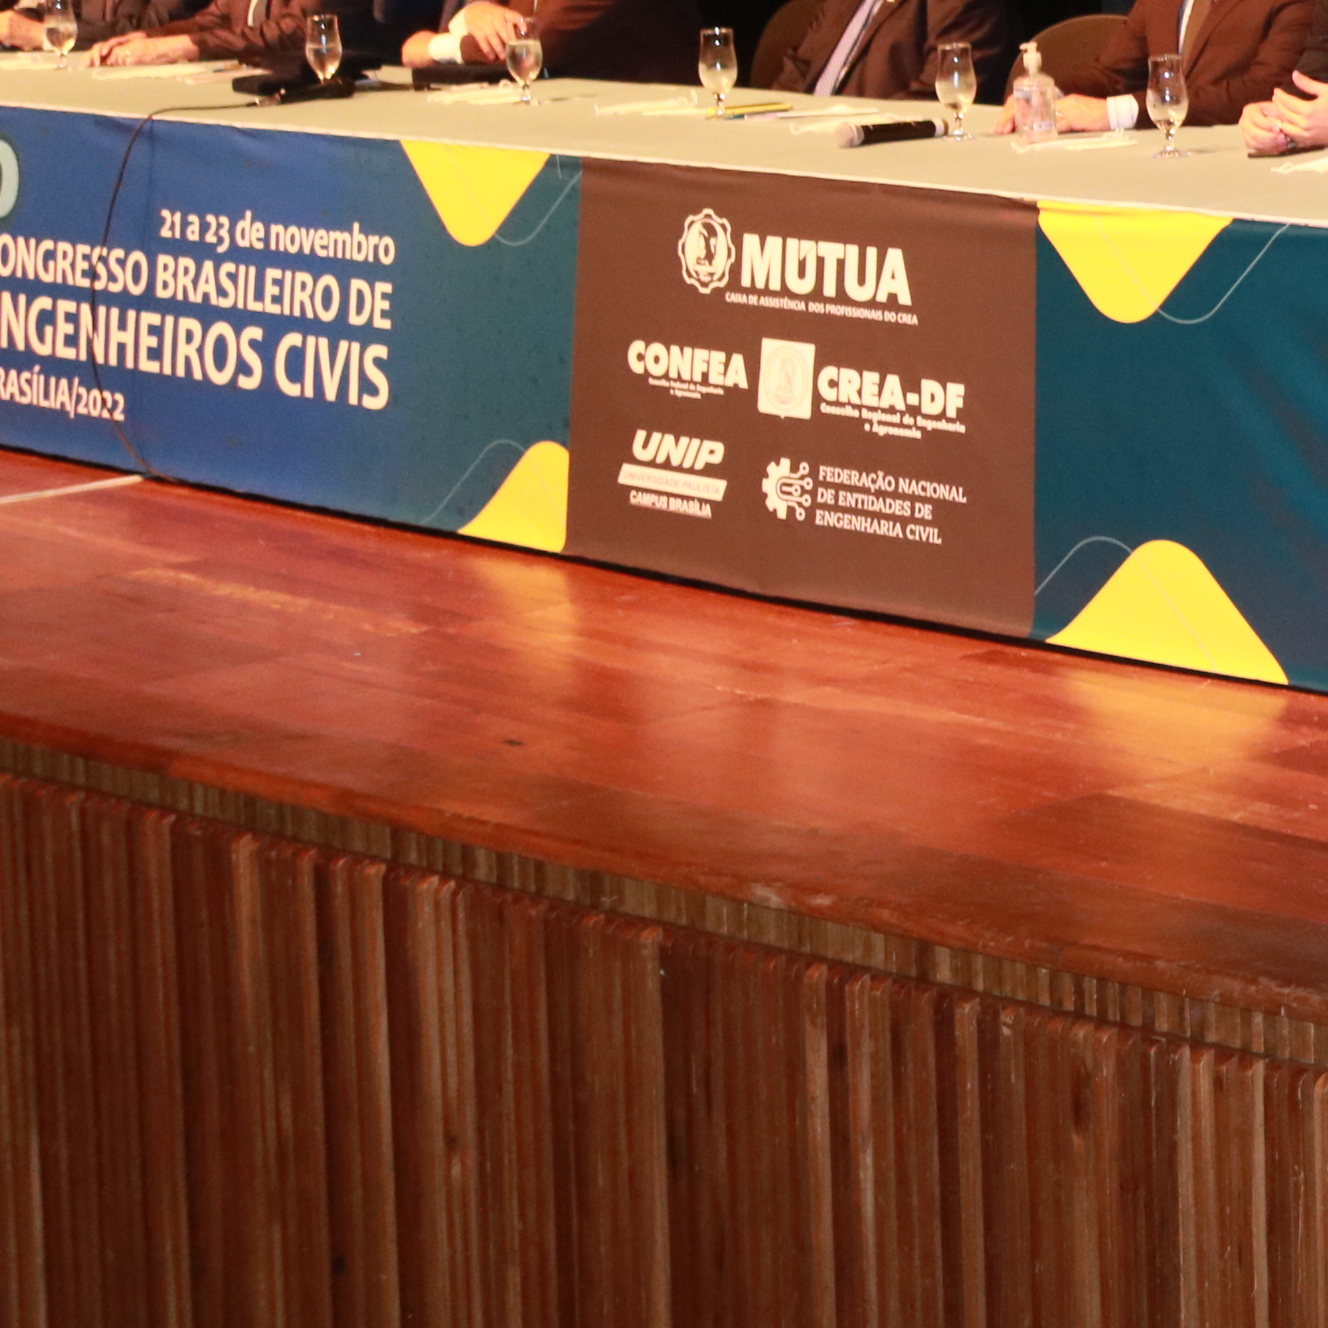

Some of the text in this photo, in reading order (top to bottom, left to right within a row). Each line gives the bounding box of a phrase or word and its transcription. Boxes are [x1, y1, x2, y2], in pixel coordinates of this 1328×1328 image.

[160, 209, 396, 265] 21 a 23 de novembro
[155, 254, 341, 322] BRASILEIRO
[348, 278, 393, 330] DE
[741, 233, 912, 306] MÚTUA
[725, 291, 919, 326] CAIXA DE ASSISTÊNCIA DOS PROFISSIONAIS DO CREA
[274, 332, 390, 411] CIVIS
[627, 340, 749, 389] CONFEA
[817, 365, 965, 418] CREA-DF
[632, 429, 725, 471] UNIP
[629, 489, 712, 517] CAMPUS BRASÍLIA
[817, 487, 933, 520] DE ENTIDADES DE
[819, 465, 967, 504] FEDERAÇÃO NACIONAL
[815, 509, 942, 545] ENGENHARIA CIVIL
